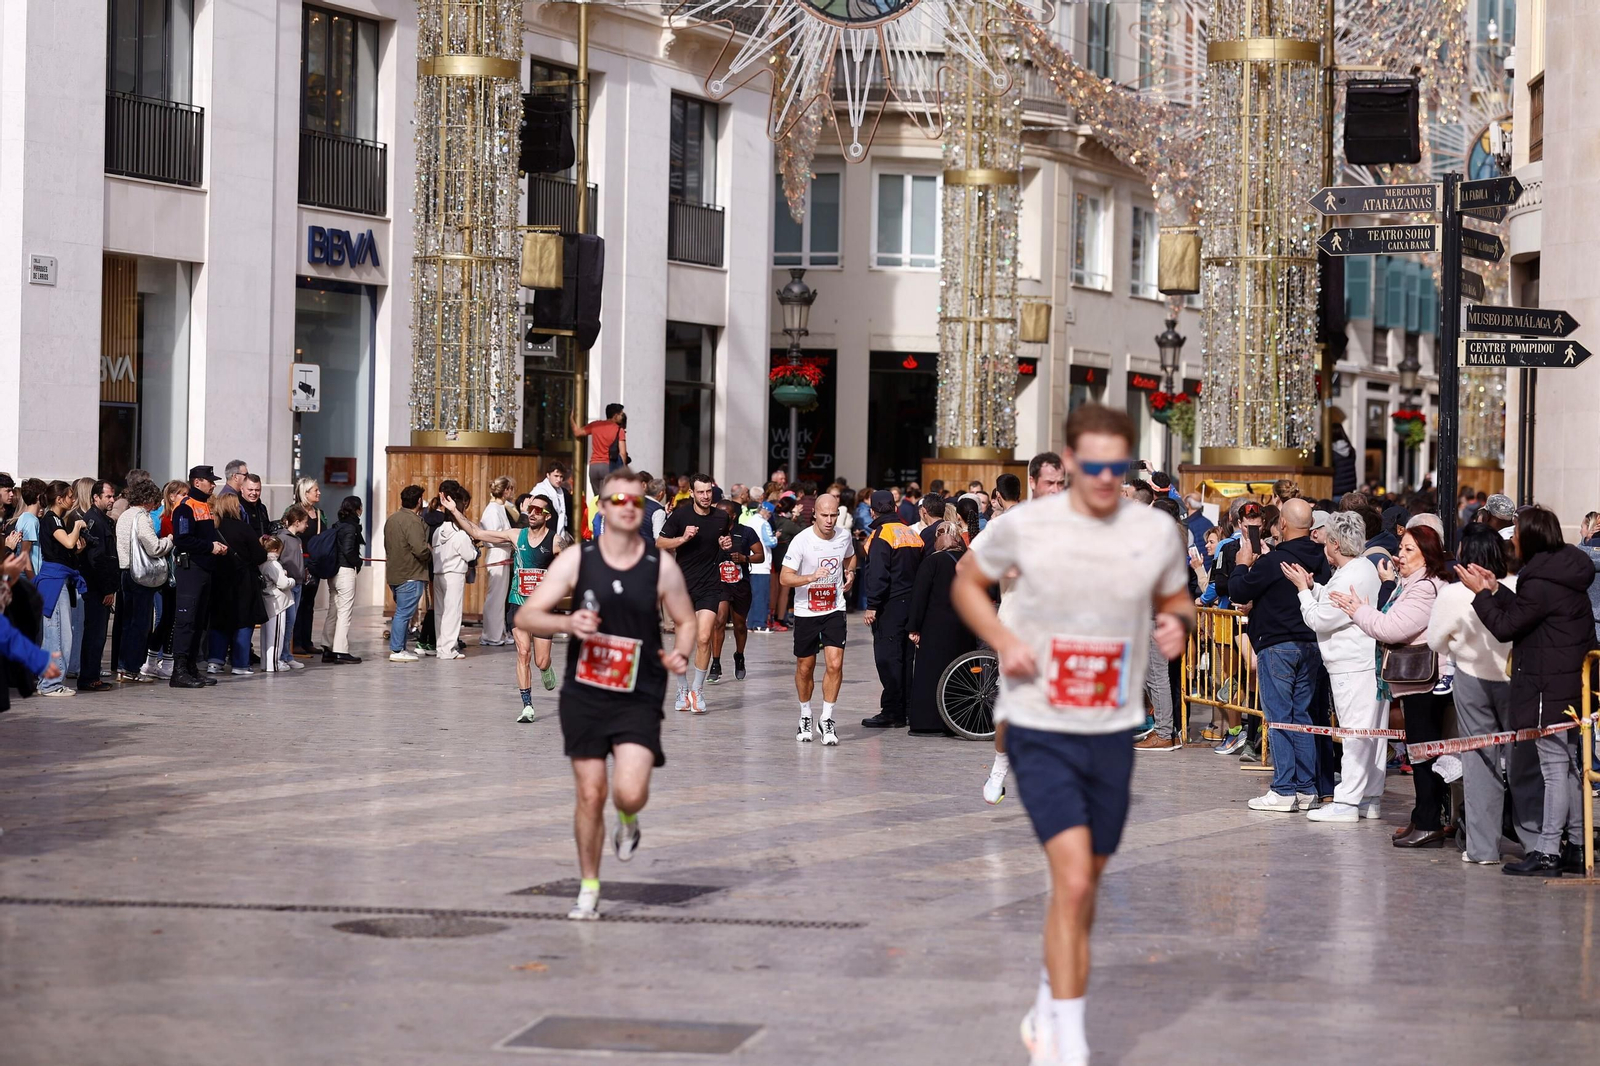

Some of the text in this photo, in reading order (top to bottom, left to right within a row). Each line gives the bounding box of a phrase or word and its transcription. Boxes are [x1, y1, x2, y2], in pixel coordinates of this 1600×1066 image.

[1385, 187, 1432, 197] MERCADO DE
[1462, 190, 1469, 202] LA
[1362, 197, 1432, 211] ATARAZANAS
[1367, 228, 1431, 241] TEATRO SOHO
[307, 225, 380, 268] BBVA
[1387, 240, 1430, 250] CAIXA BANK
[1468, 312, 1551, 329] MUSEO DE MÁLAGA
[1470, 342, 1555, 353] CENTRE POMPIDOU
[1469, 352, 1506, 364] MÁLAGA
[99, 354, 135, 384] BVA
